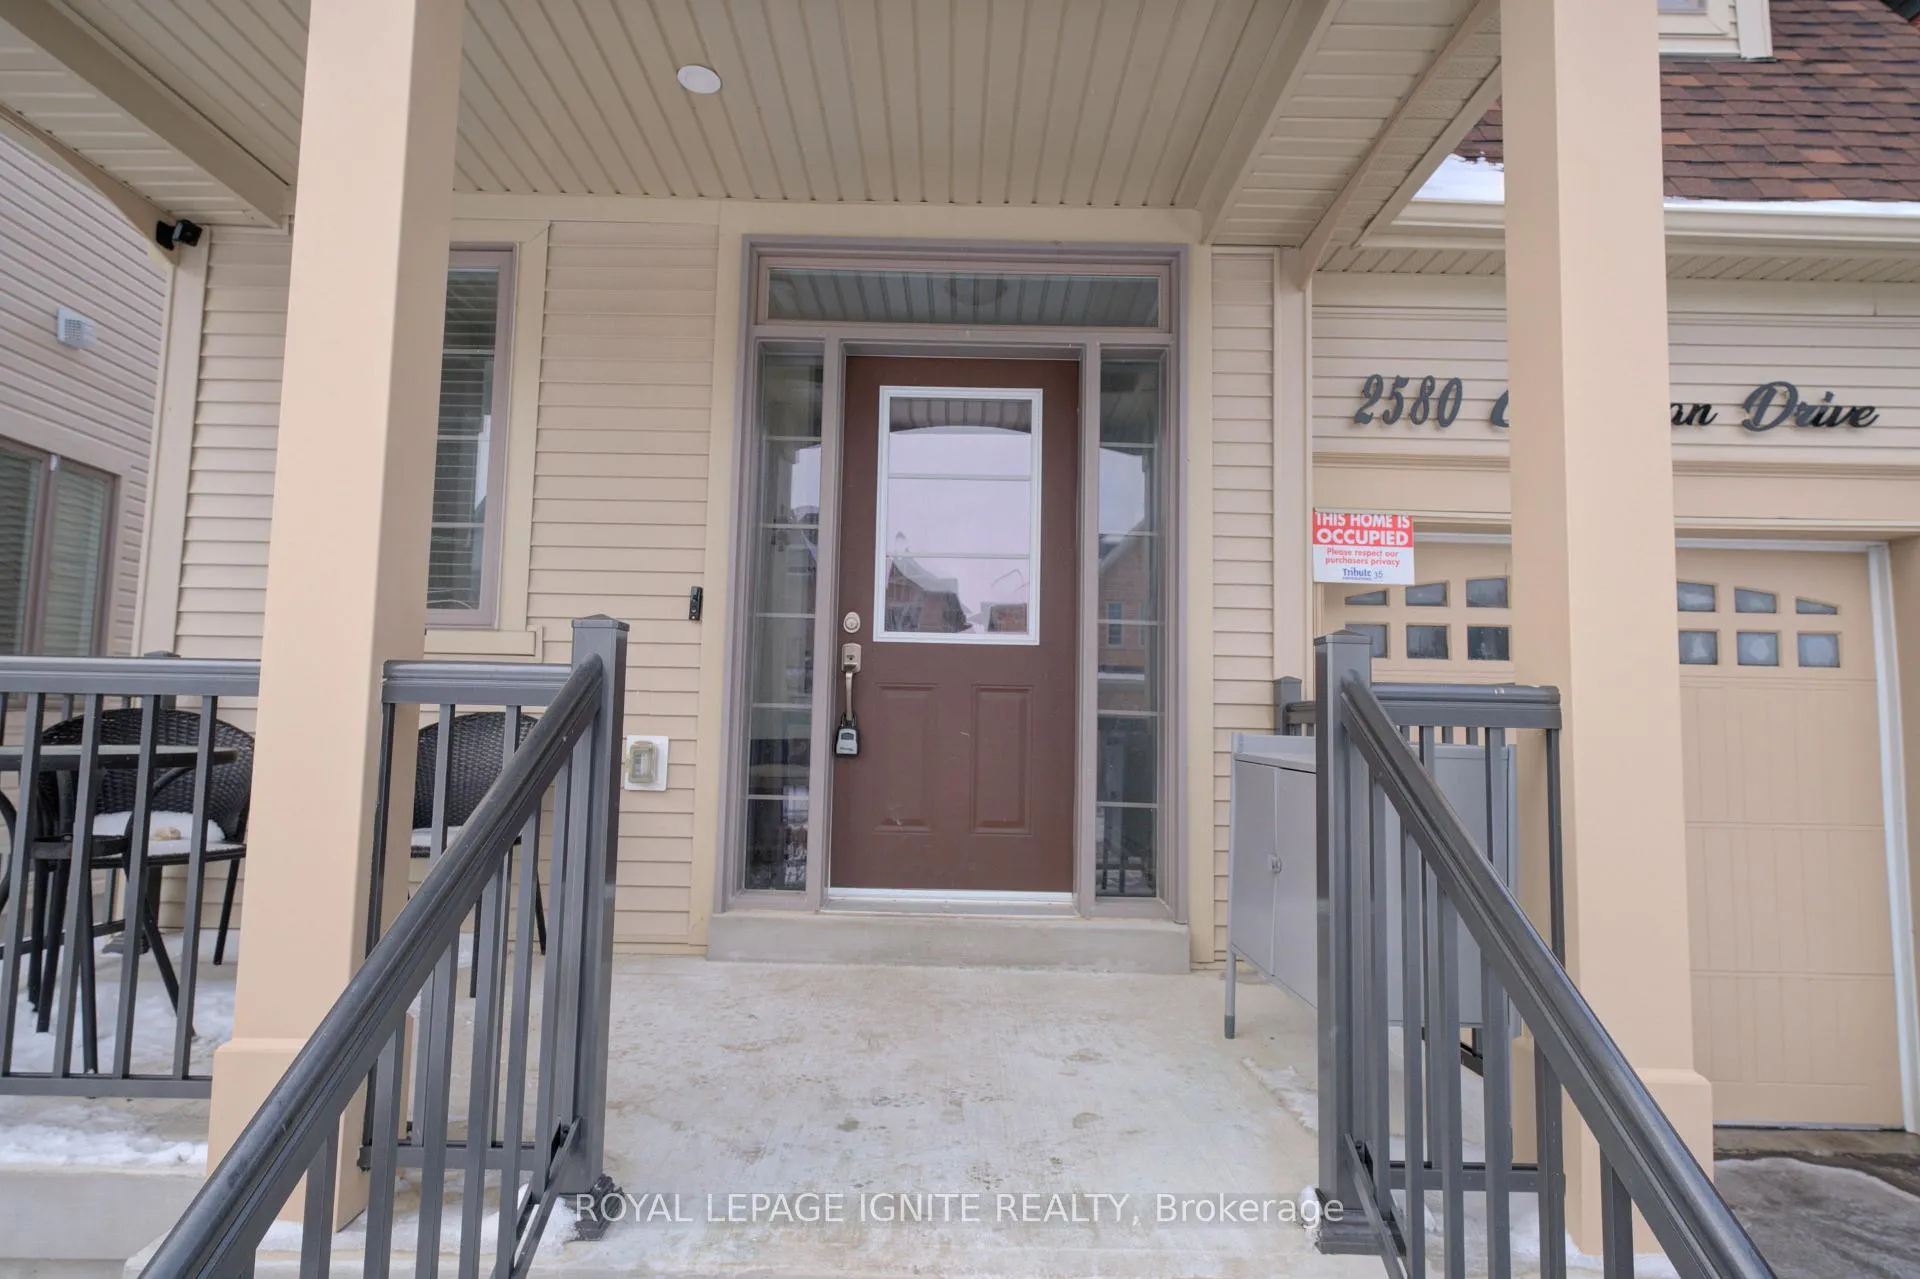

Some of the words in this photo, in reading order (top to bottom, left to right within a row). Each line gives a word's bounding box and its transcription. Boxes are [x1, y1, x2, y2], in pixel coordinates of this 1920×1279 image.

[1354, 373, 1463, 428] 2580
[1742, 381, 1880, 432] Drive
[1316, 512, 1346, 527] THIS
[1350, 513, 1393, 528] HOME
[1397, 515, 1410, 529] IS
[1316, 528, 1409, 546] OCCUPIED
[1327, 547, 1352, 556] Please
[1355, 549, 1382, 558] respect
[1325, 556, 1368, 565] purchasers
[1371, 559, 1400, 567] privacy
[1343, 567, 1372, 576] Tribute
